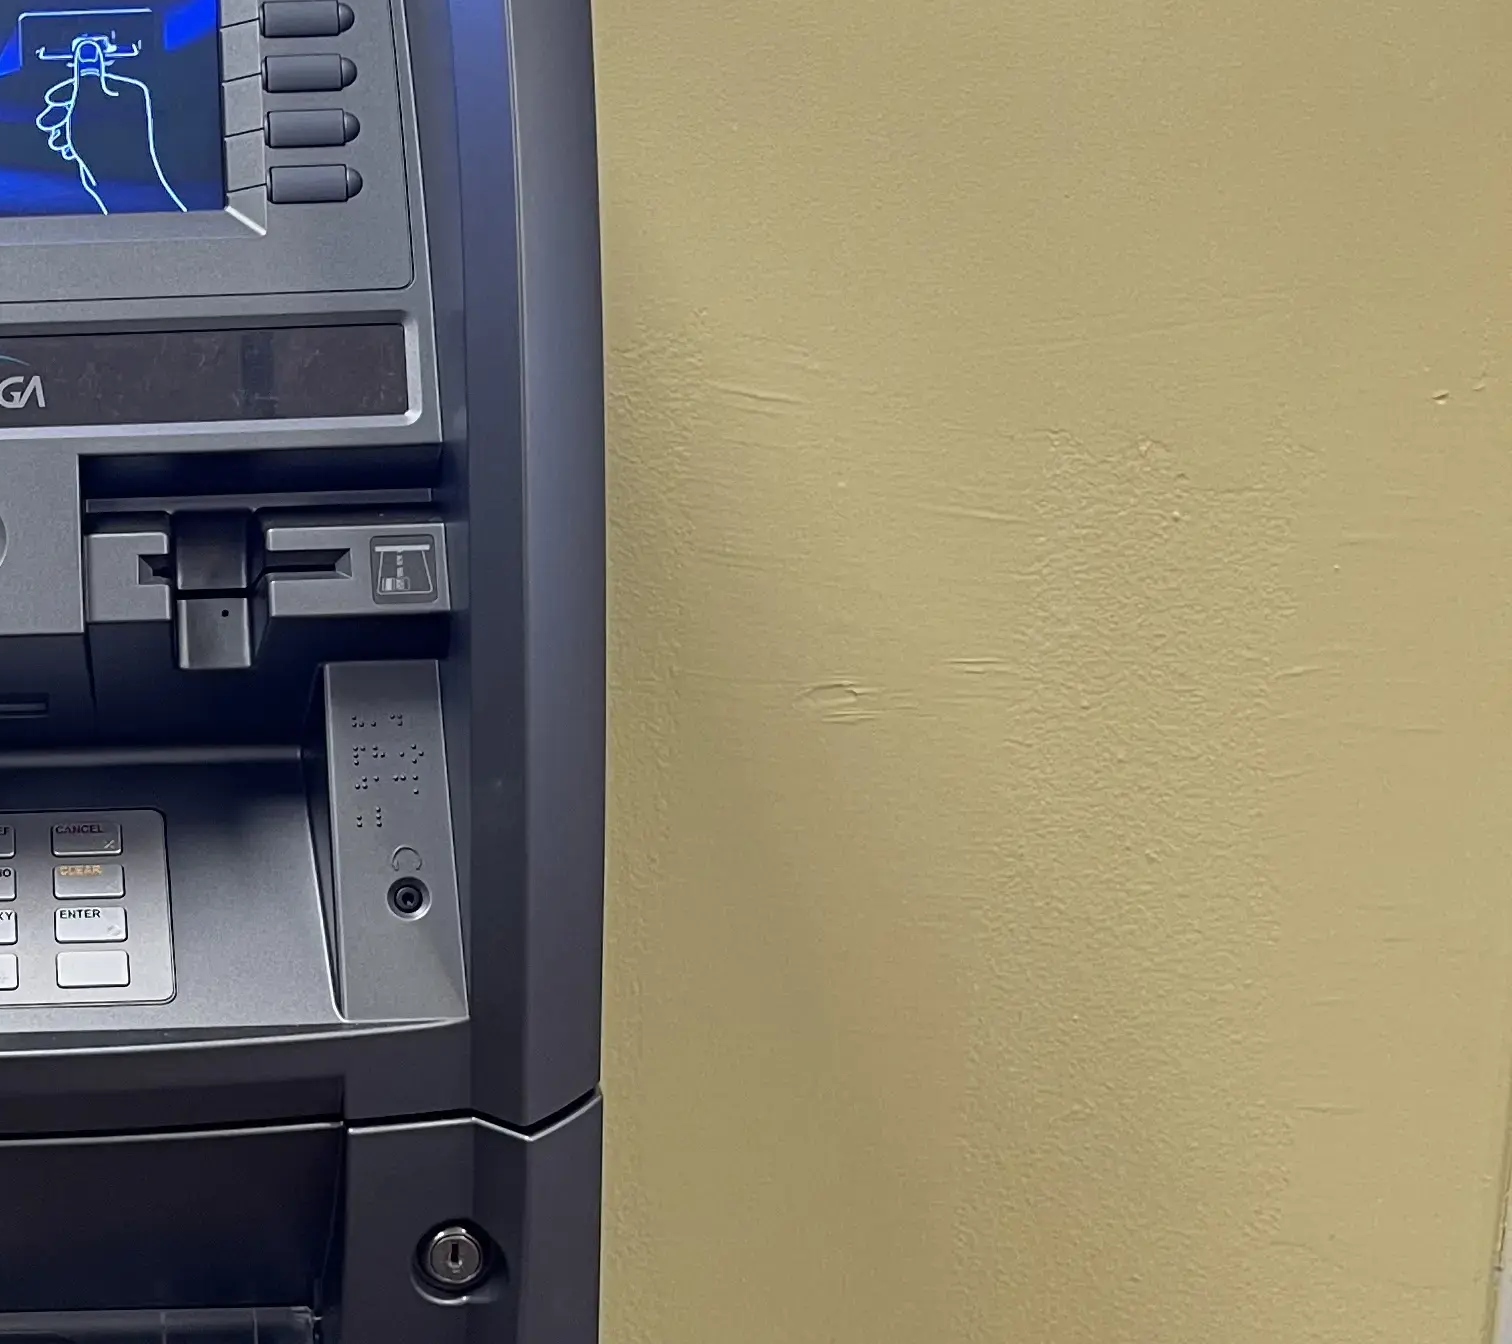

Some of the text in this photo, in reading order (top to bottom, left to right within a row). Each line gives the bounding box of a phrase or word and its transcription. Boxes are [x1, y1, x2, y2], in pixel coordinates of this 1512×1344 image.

[56, 825, 104, 834] CANCEL
[60, 865, 102, 875] CLEAR
[60, 909, 100, 919] ENTER
